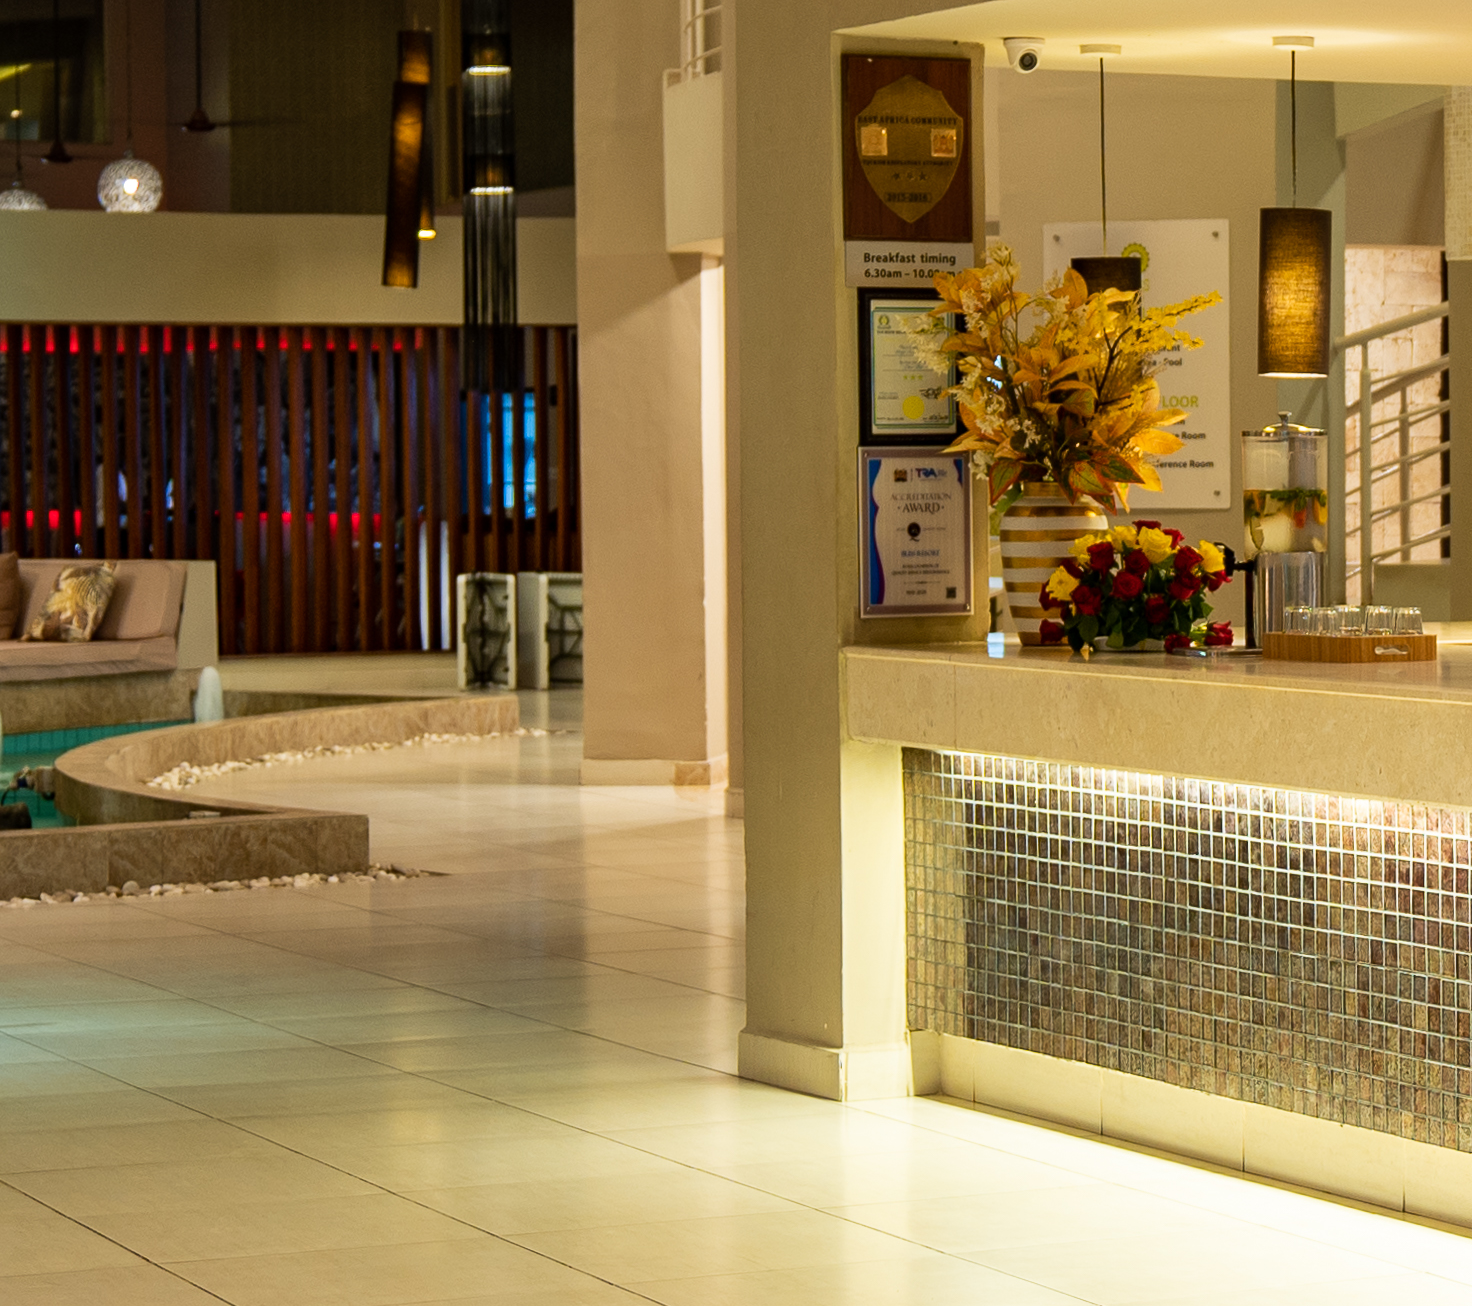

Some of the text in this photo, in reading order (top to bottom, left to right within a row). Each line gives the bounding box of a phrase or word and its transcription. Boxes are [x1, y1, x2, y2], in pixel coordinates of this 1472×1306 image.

[863, 252, 956, 266] Breakfast timing
[864, 268, 902, 278] 6.30am
[1161, 395, 1199, 408] LOOR
[1181, 431, 1206, 439] Room
[1189, 460, 1214, 468] Room
[891, 493, 952, 501] ACCREDITATION
[902, 502, 941, 514] AWARD
